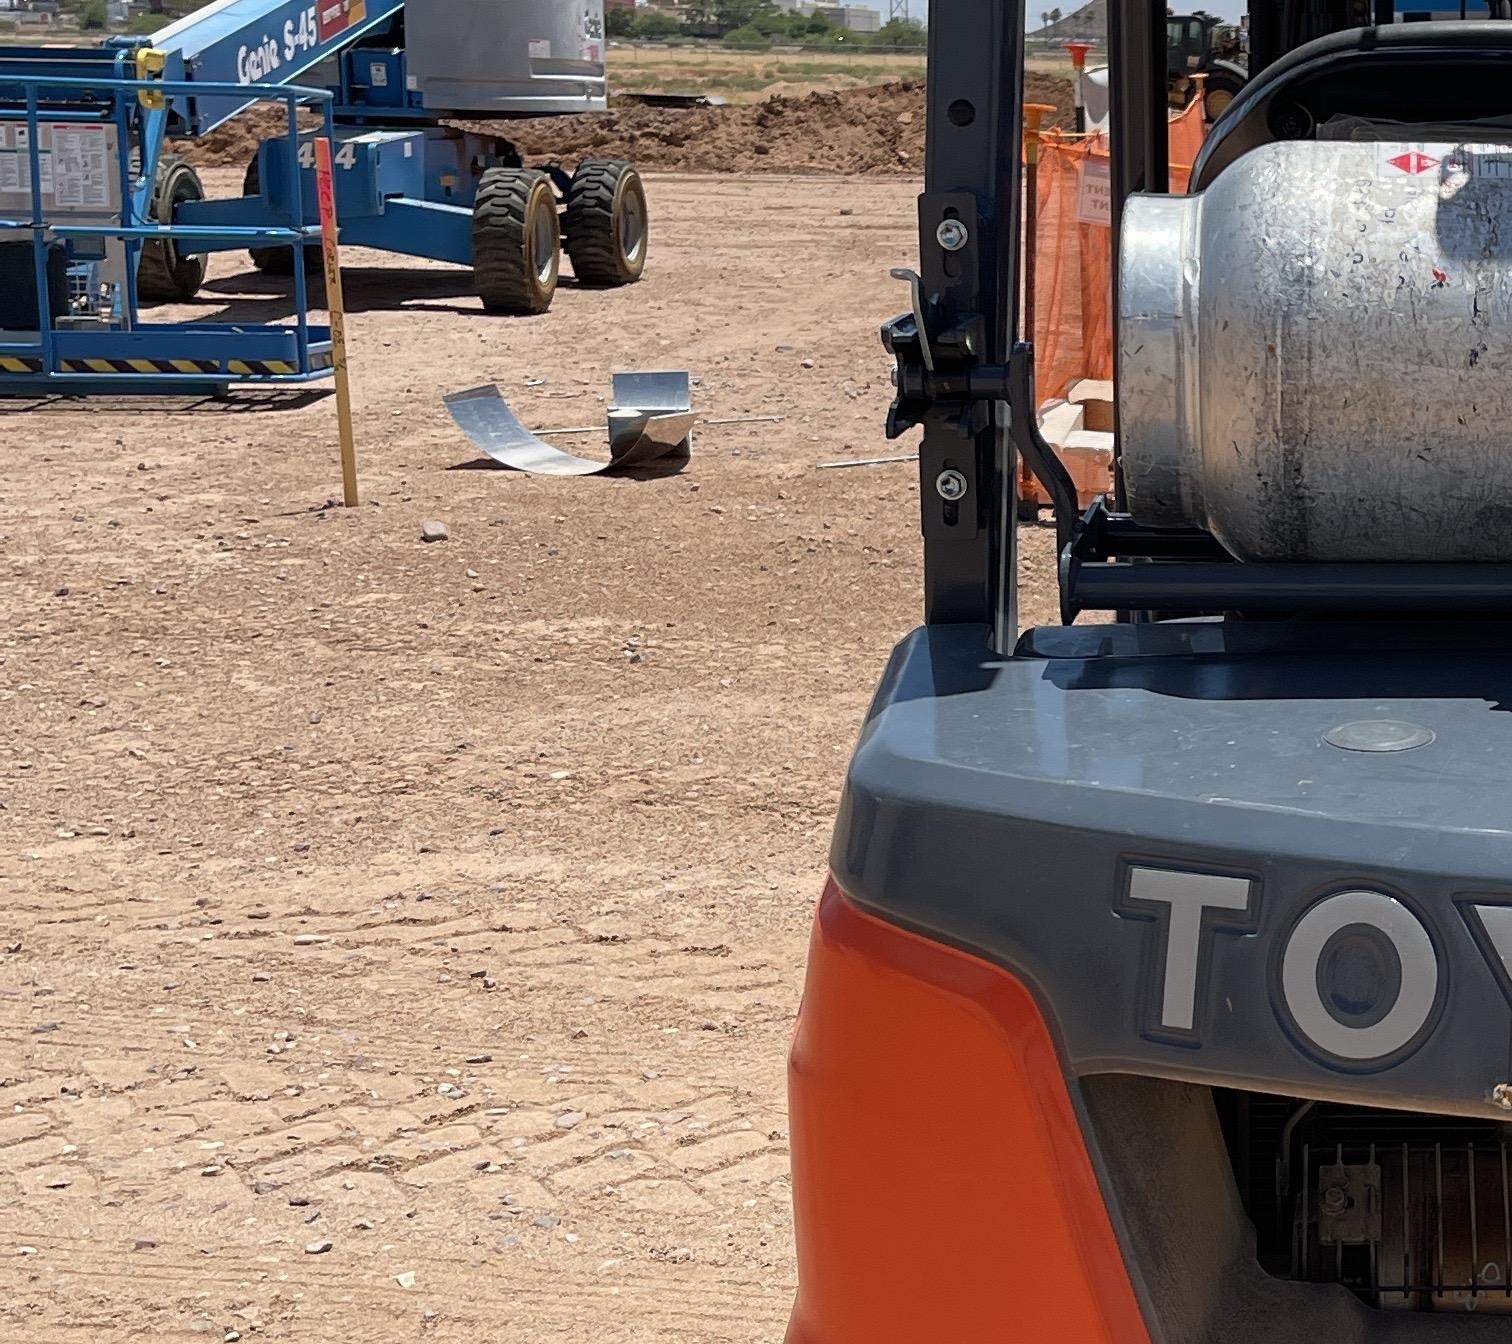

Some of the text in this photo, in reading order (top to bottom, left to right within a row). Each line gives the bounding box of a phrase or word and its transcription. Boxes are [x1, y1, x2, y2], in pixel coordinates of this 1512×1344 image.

[237, 34, 280, 85] Genie
[283, 6, 317, 61] S-45
[297, 141, 357, 171] 44
